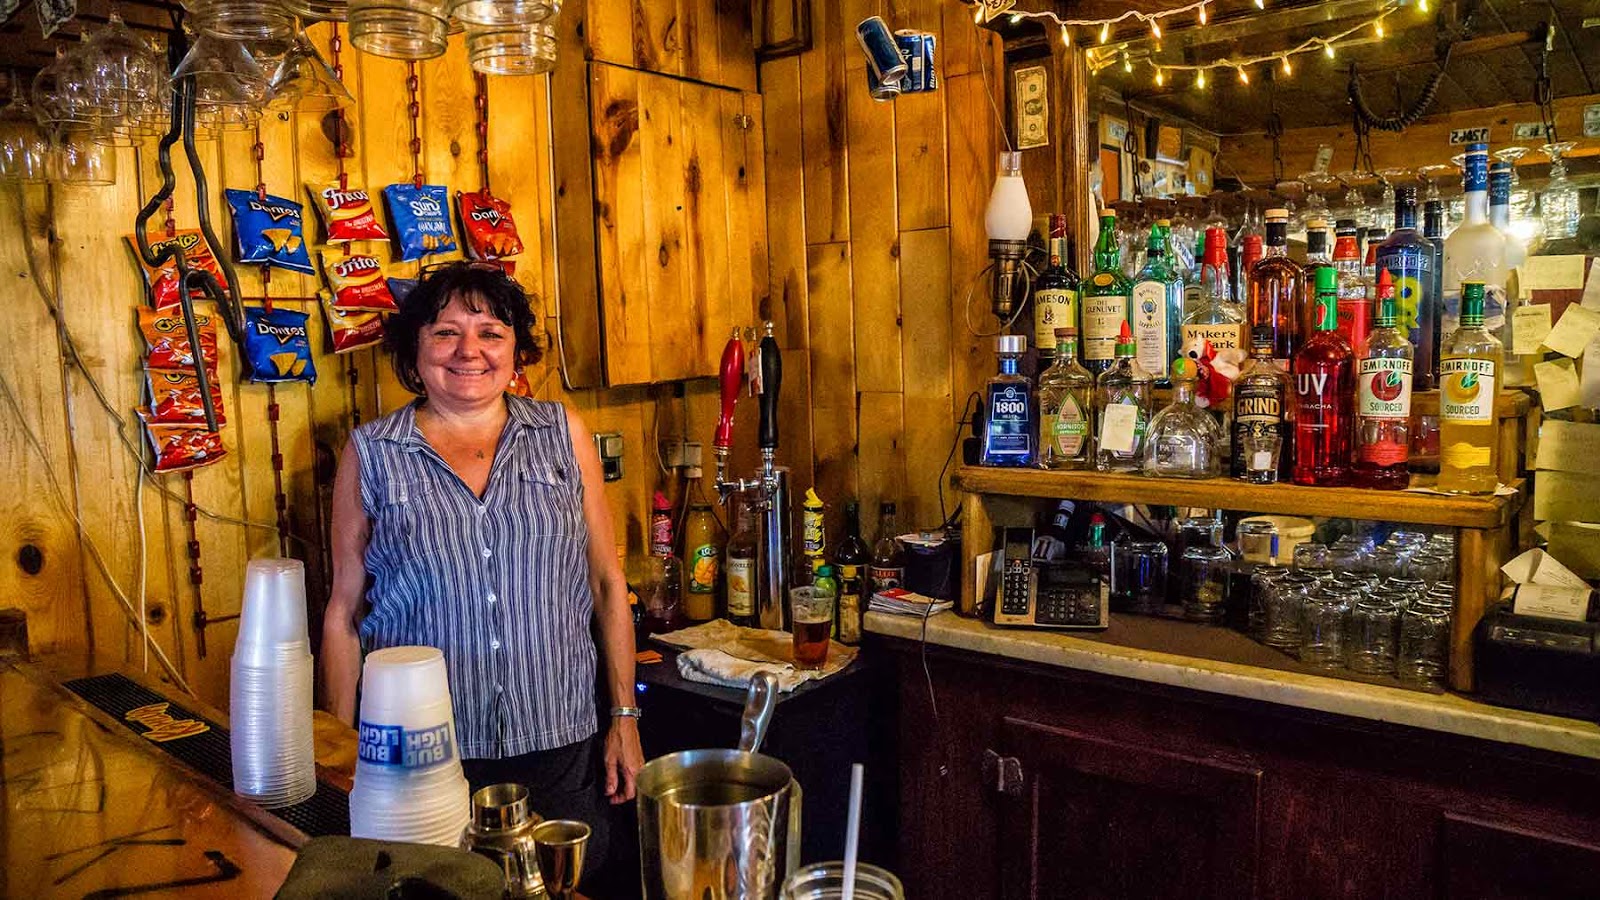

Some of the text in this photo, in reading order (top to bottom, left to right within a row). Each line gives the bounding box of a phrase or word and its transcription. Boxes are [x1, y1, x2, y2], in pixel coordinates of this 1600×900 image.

[322, 187, 370, 209] Fritos
[249, 200, 300, 218] Doritos
[471, 208, 511, 221] Dori
[333, 256, 380, 277] Fritos
[1036, 294, 1071, 305] AMESON
[1086, 305, 1122, 314] GLENLIVET
[257, 323, 306, 336] Doritos
[1187, 330, 1236, 339] Maker's
[1211, 340, 1236, 349] ark
[1363, 361, 1410, 371] SMIRNOFF
[1441, 361, 1490, 372] SMIRNOFF
[1298, 373, 1327, 396] UV
[995, 401, 1025, 414] 1800
[1238, 397, 1280, 415] GRIND
[1370, 402, 1402, 412] SOURCED
[1445, 404, 1480, 415] SOURCED
[361, 725, 399, 746] LIGH
[406, 726, 449, 750] LIGH
[360, 742, 390, 762] BUD
[406, 745, 445, 768] BUD
